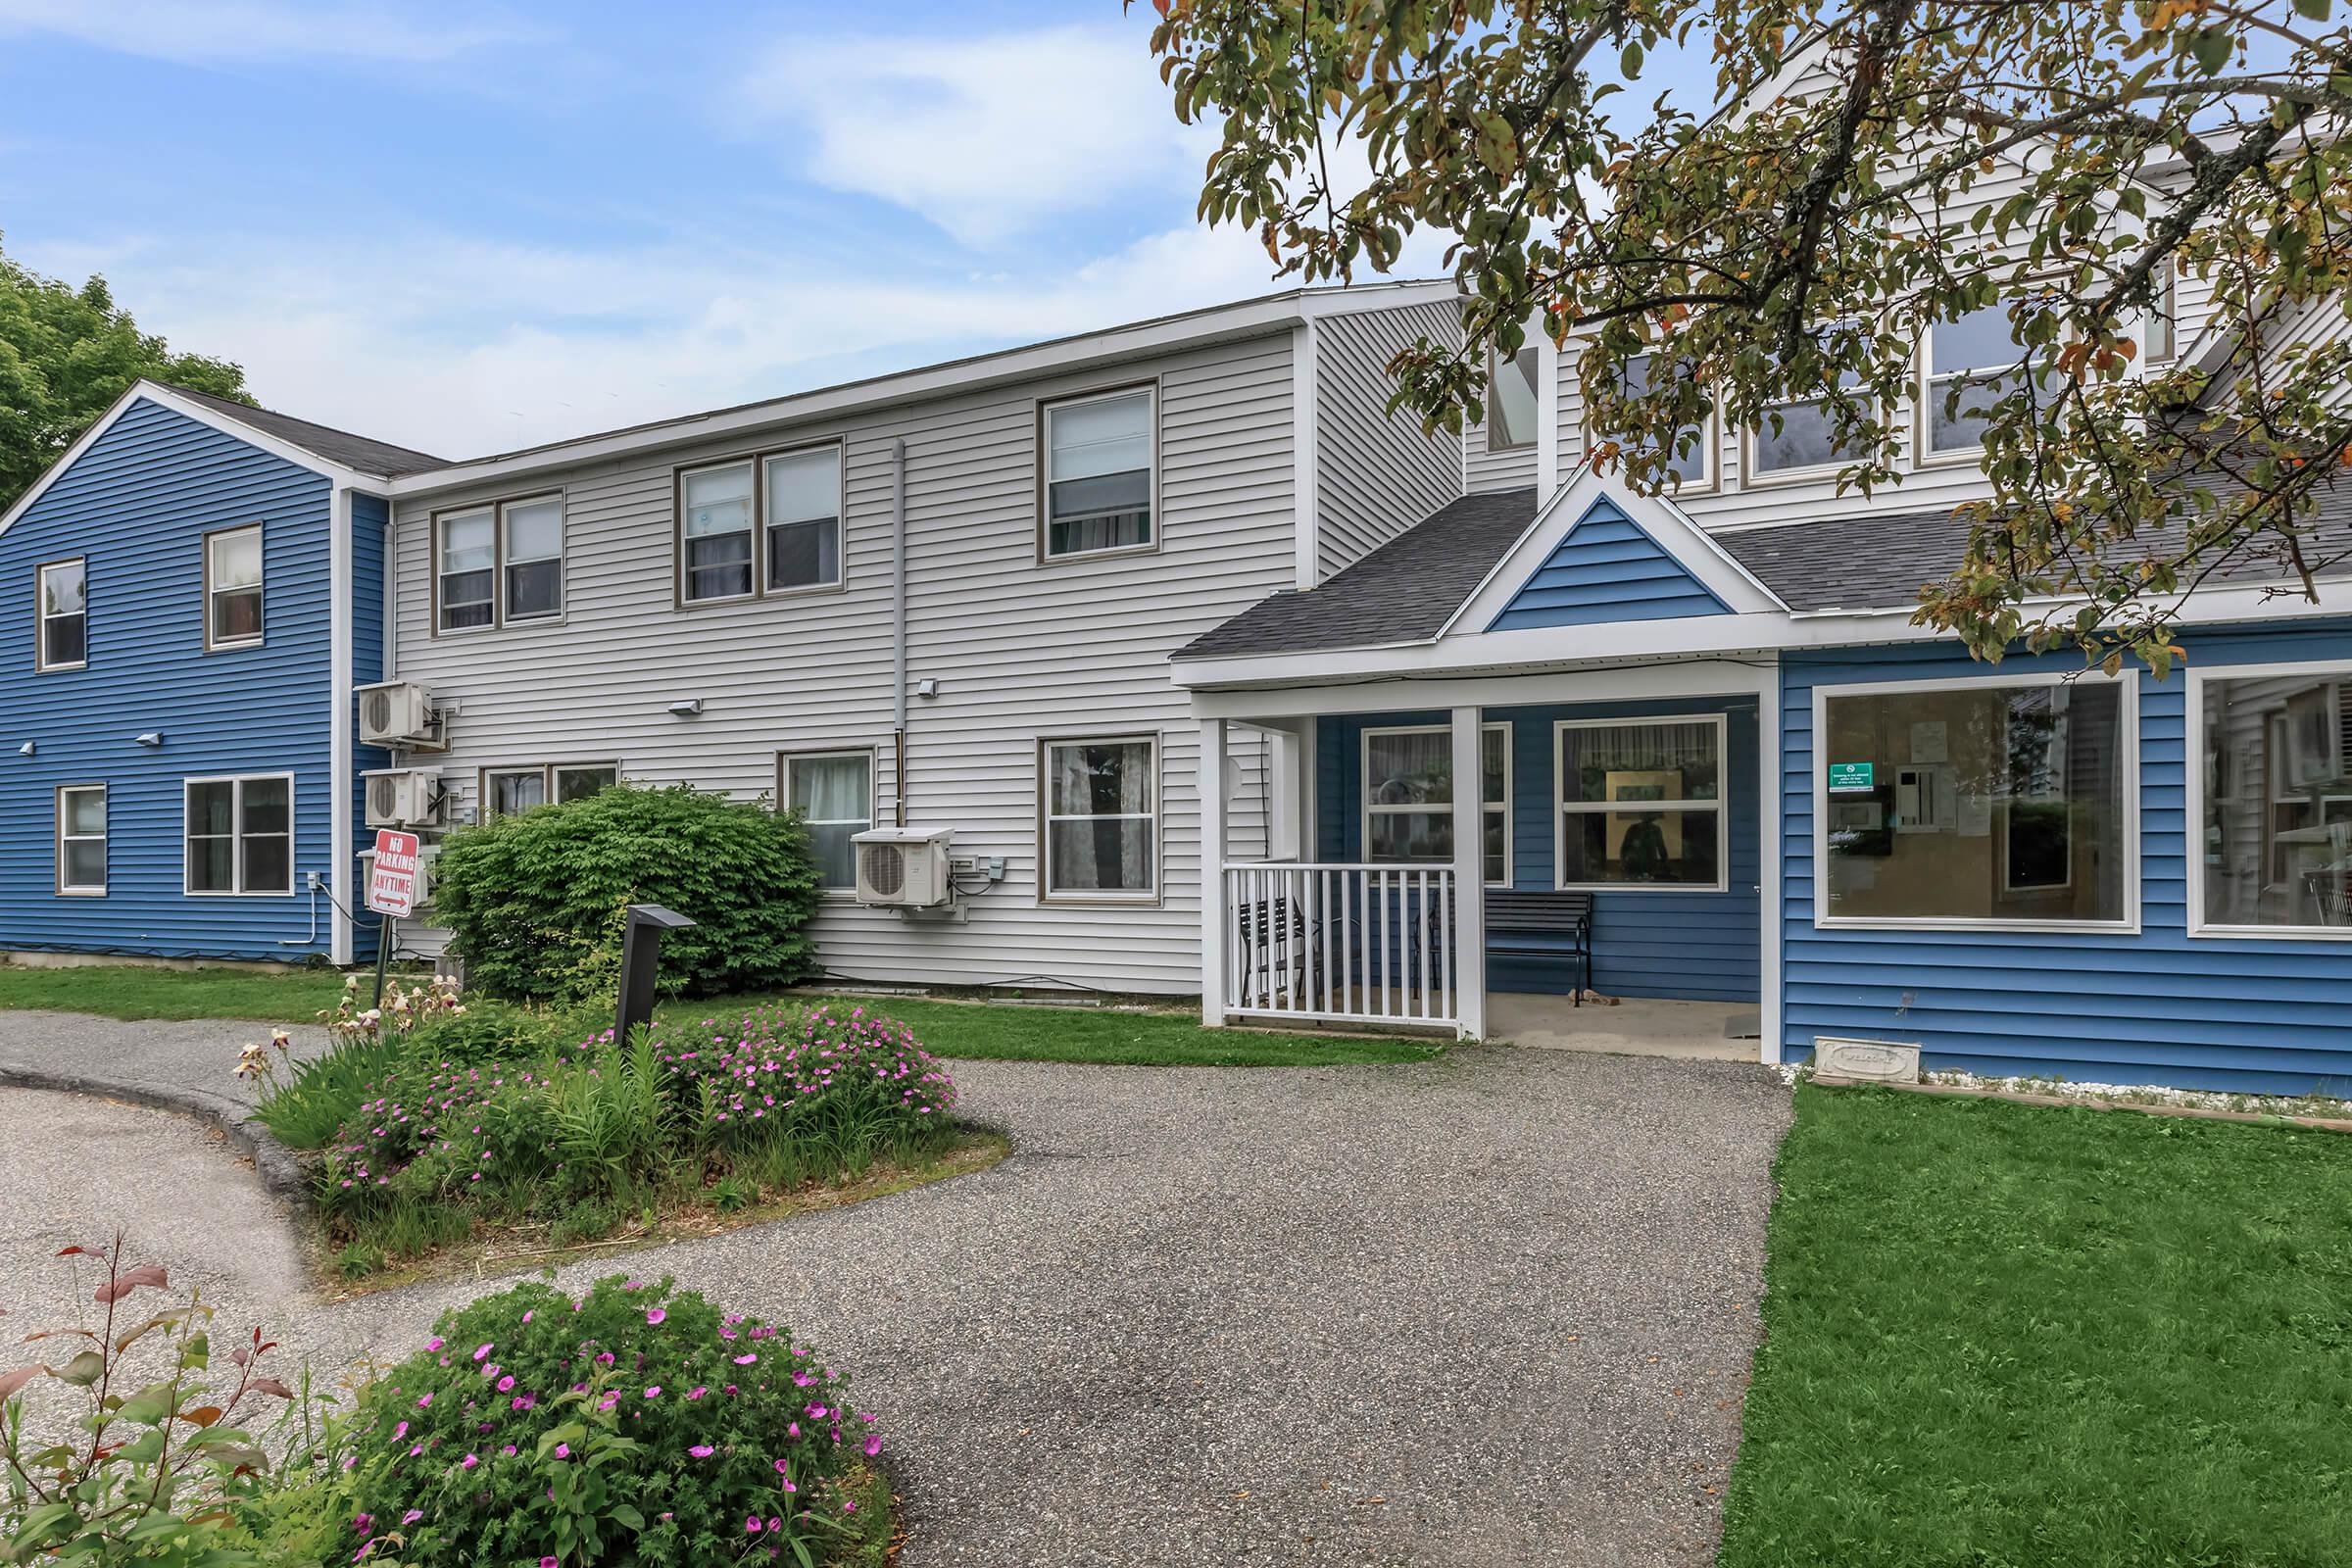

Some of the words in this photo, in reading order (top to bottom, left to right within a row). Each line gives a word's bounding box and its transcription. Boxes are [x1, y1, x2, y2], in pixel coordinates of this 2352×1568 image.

[389, 837, 404, 852] NO
[376, 851, 415, 871] PARKING
[375, 873, 411, 895] ANYTIME
